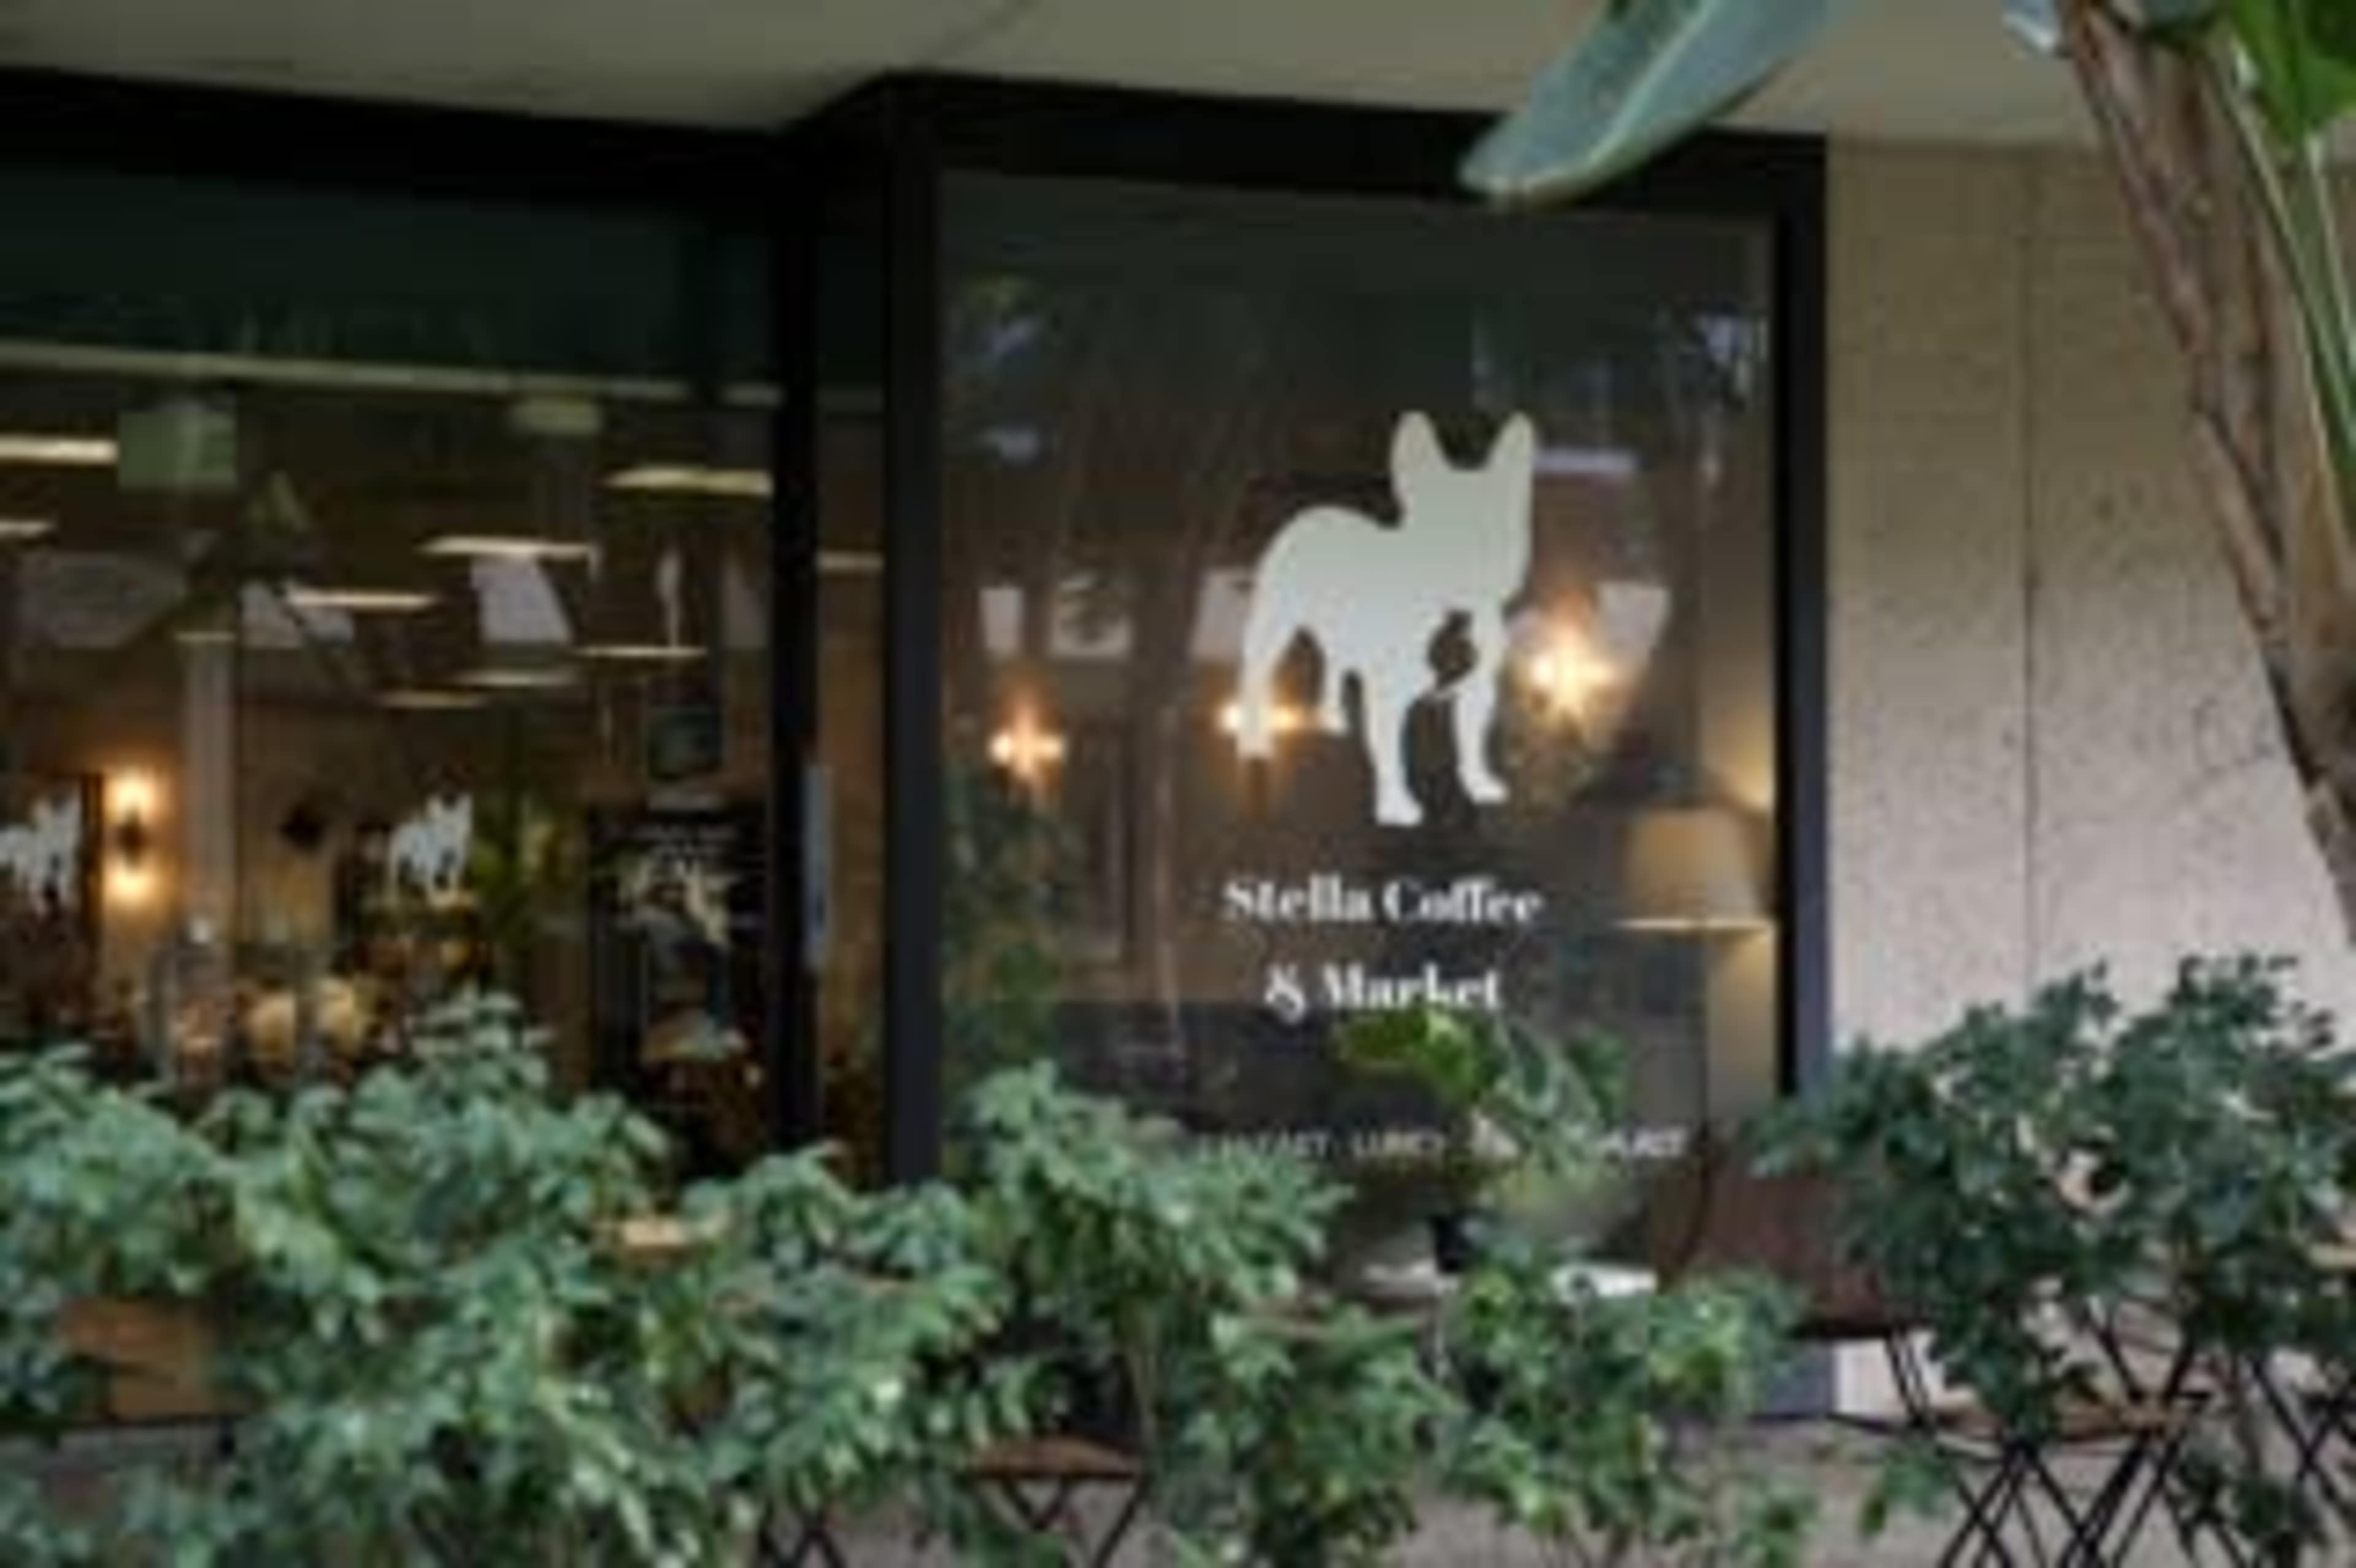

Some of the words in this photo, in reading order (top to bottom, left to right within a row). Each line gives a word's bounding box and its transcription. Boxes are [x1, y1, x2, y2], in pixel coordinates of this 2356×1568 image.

[1222, 873, 1374, 921] Stella
[1382, 876, 1544, 921] Coffee
[1265, 963, 1305, 1024] &
[1322, 962, 1501, 1010] Market
